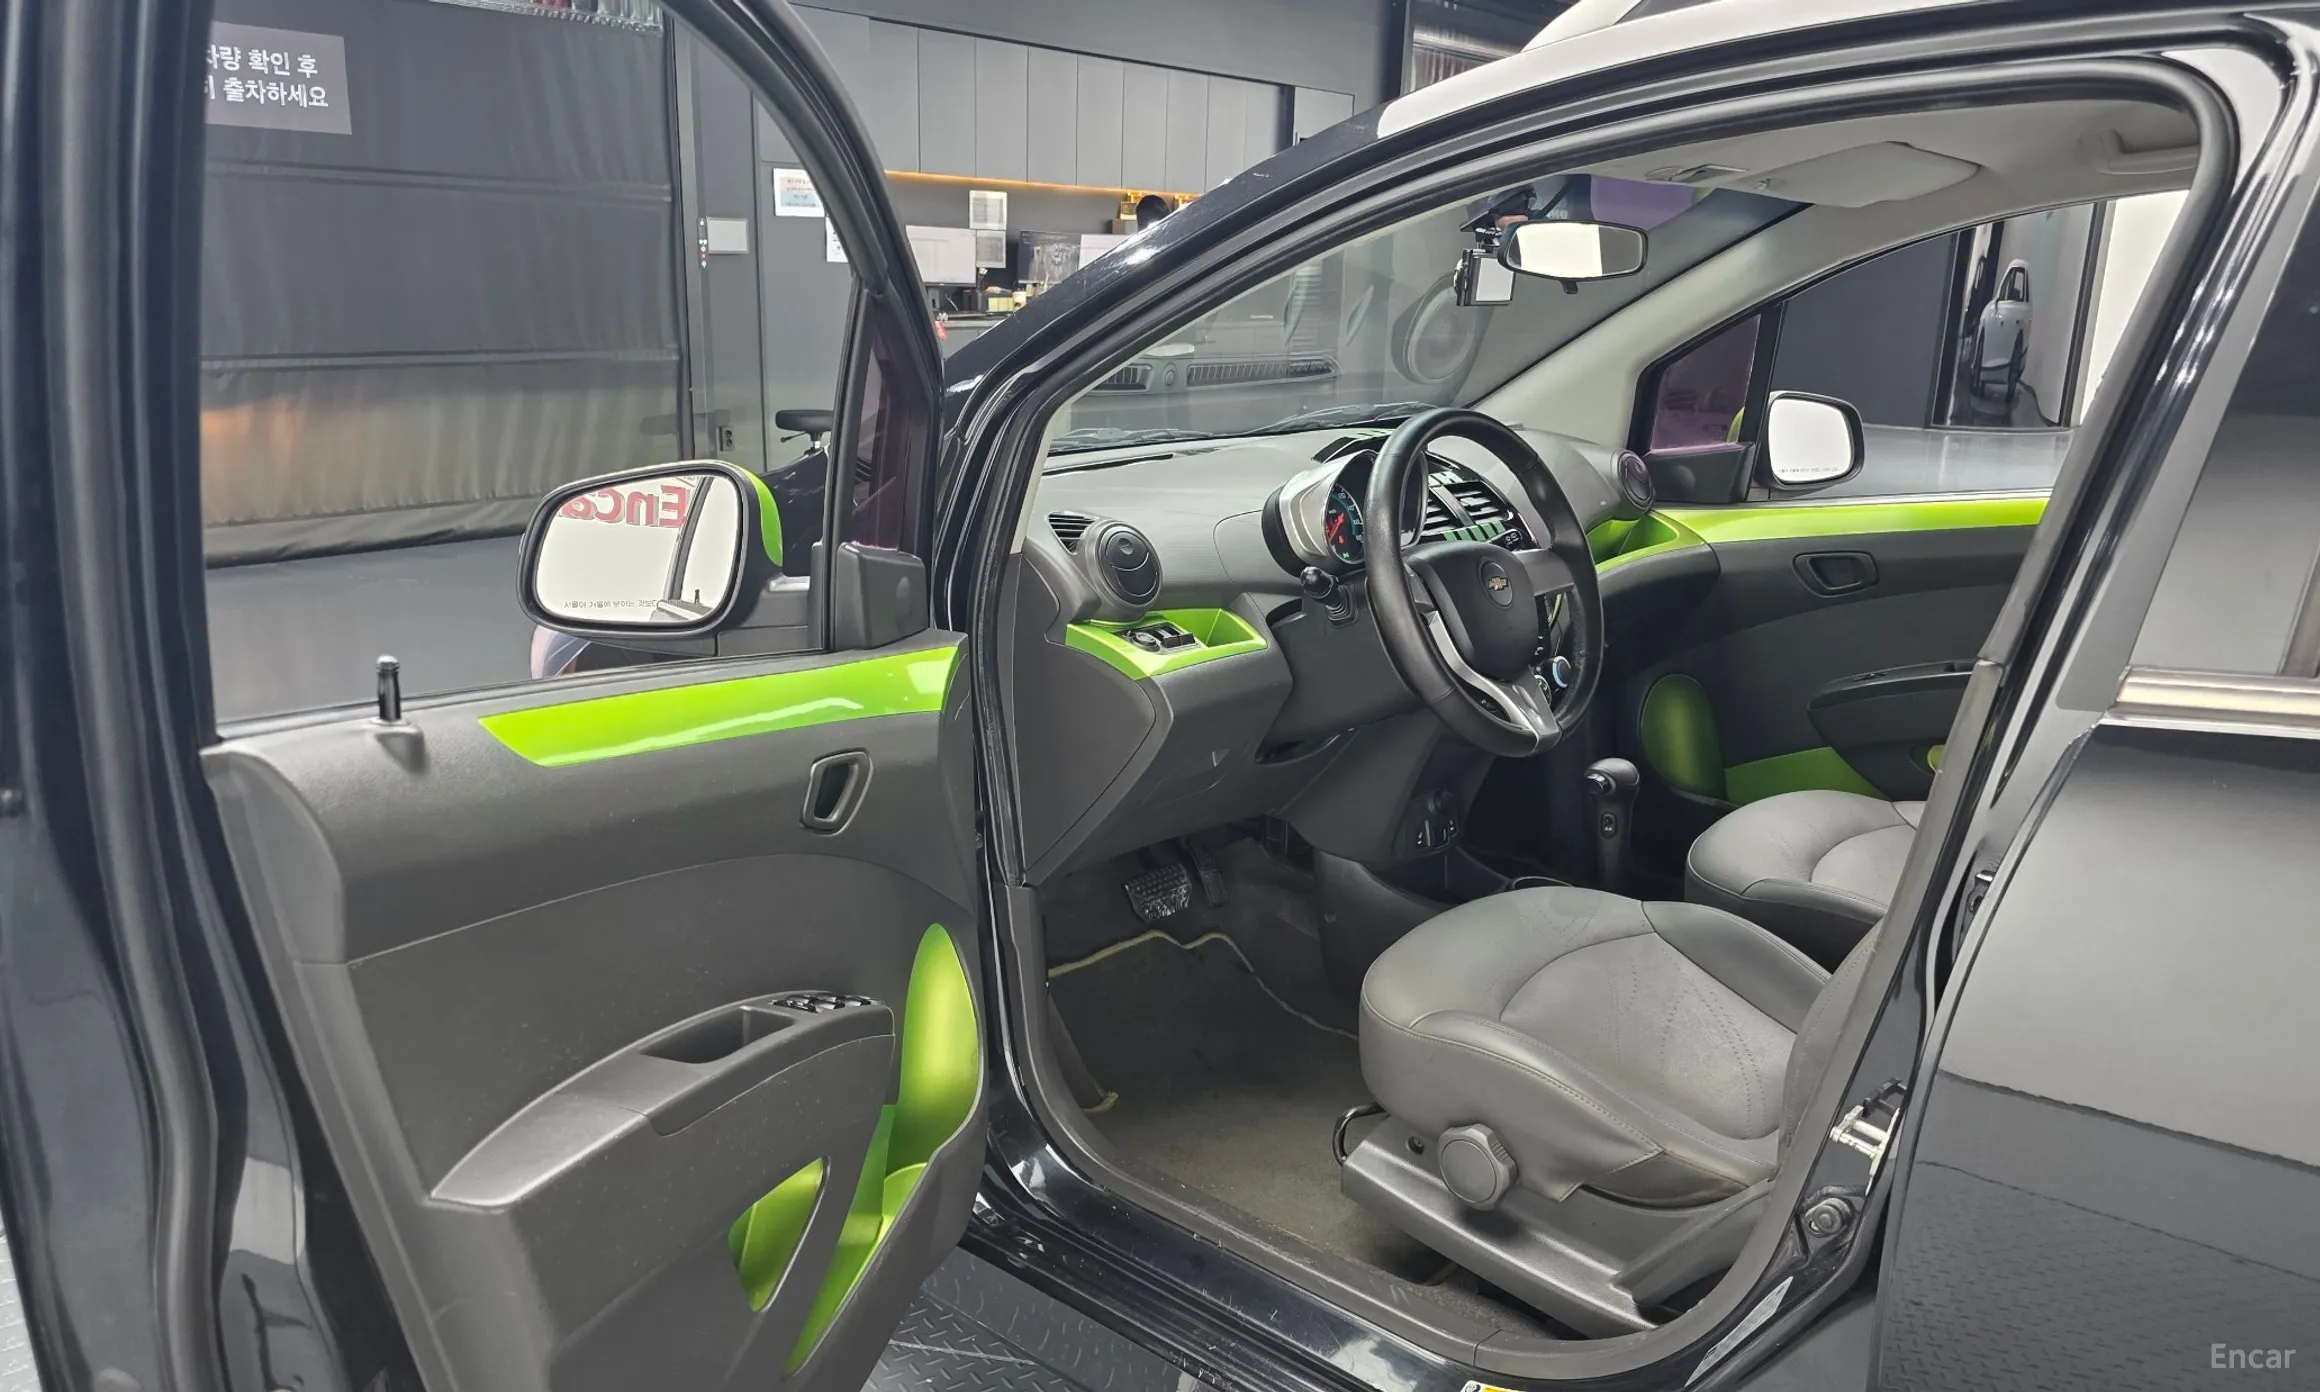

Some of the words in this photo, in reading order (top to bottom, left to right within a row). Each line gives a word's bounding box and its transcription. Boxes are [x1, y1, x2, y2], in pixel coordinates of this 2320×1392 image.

[248, 49, 291, 76] 확인
[297, 54, 318, 79] 후
[223, 77, 329, 108] 출차하세요
